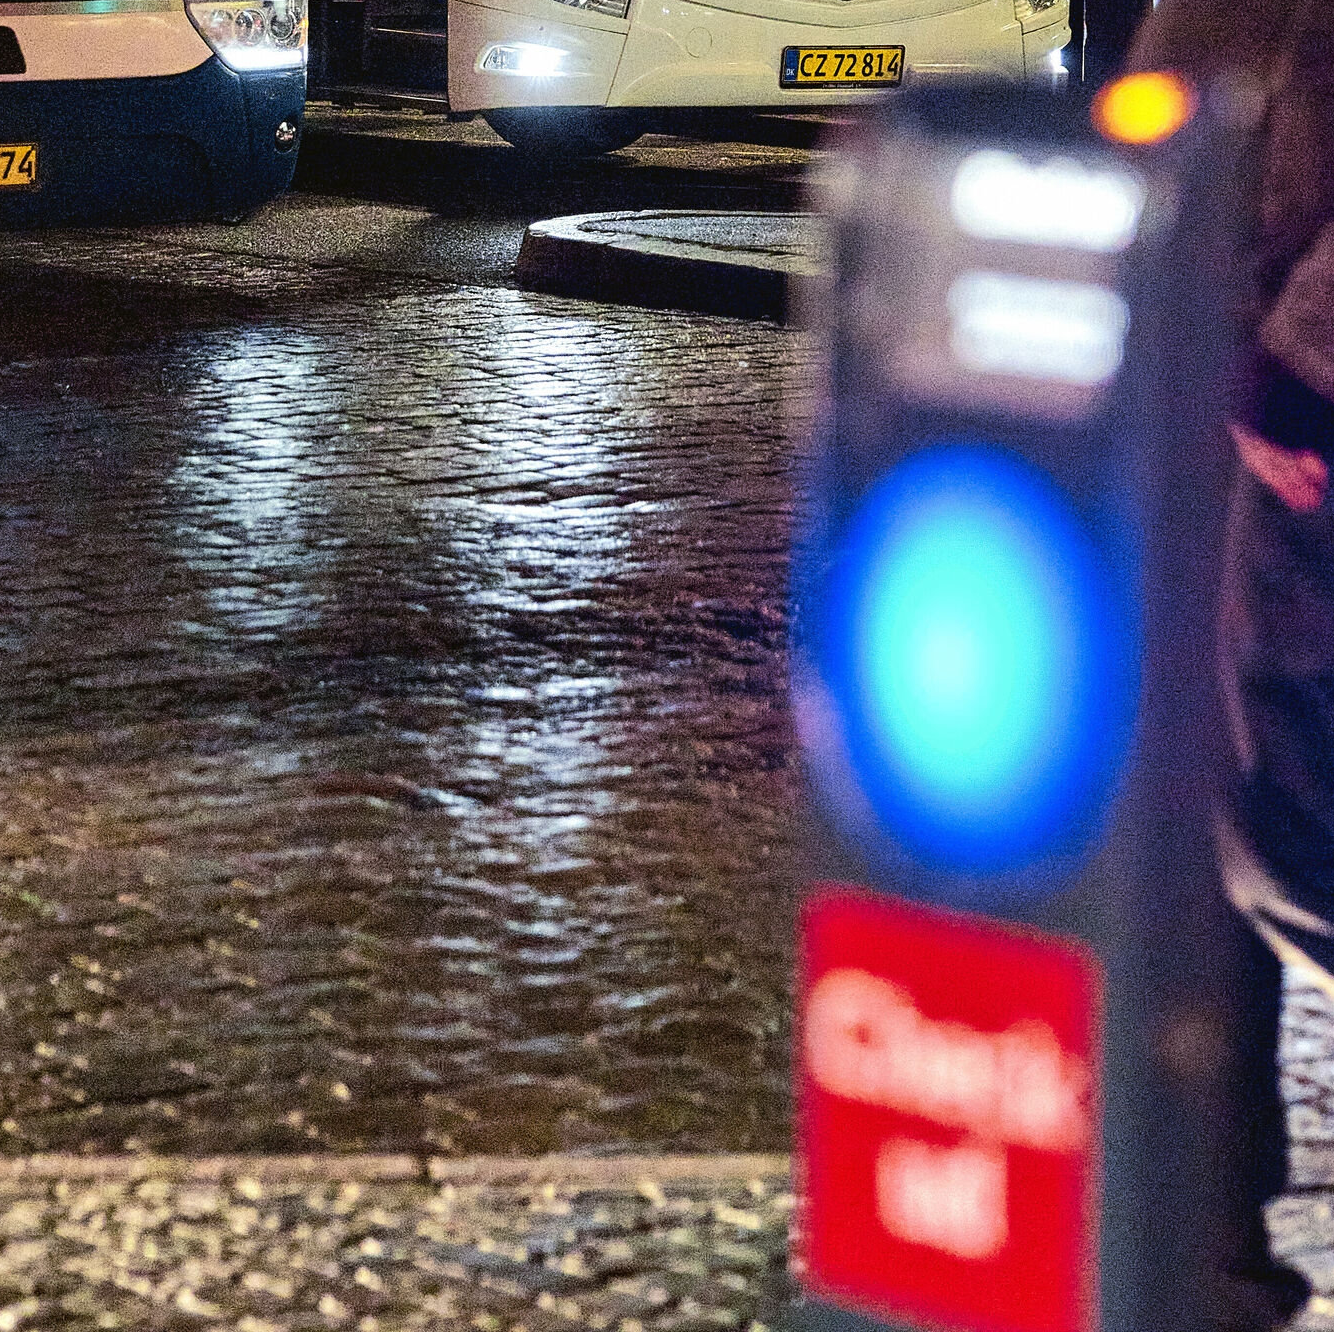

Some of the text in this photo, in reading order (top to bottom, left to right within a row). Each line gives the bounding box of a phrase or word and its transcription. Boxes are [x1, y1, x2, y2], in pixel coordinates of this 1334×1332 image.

[785, 52, 900, 77] DK CZ 72 814
